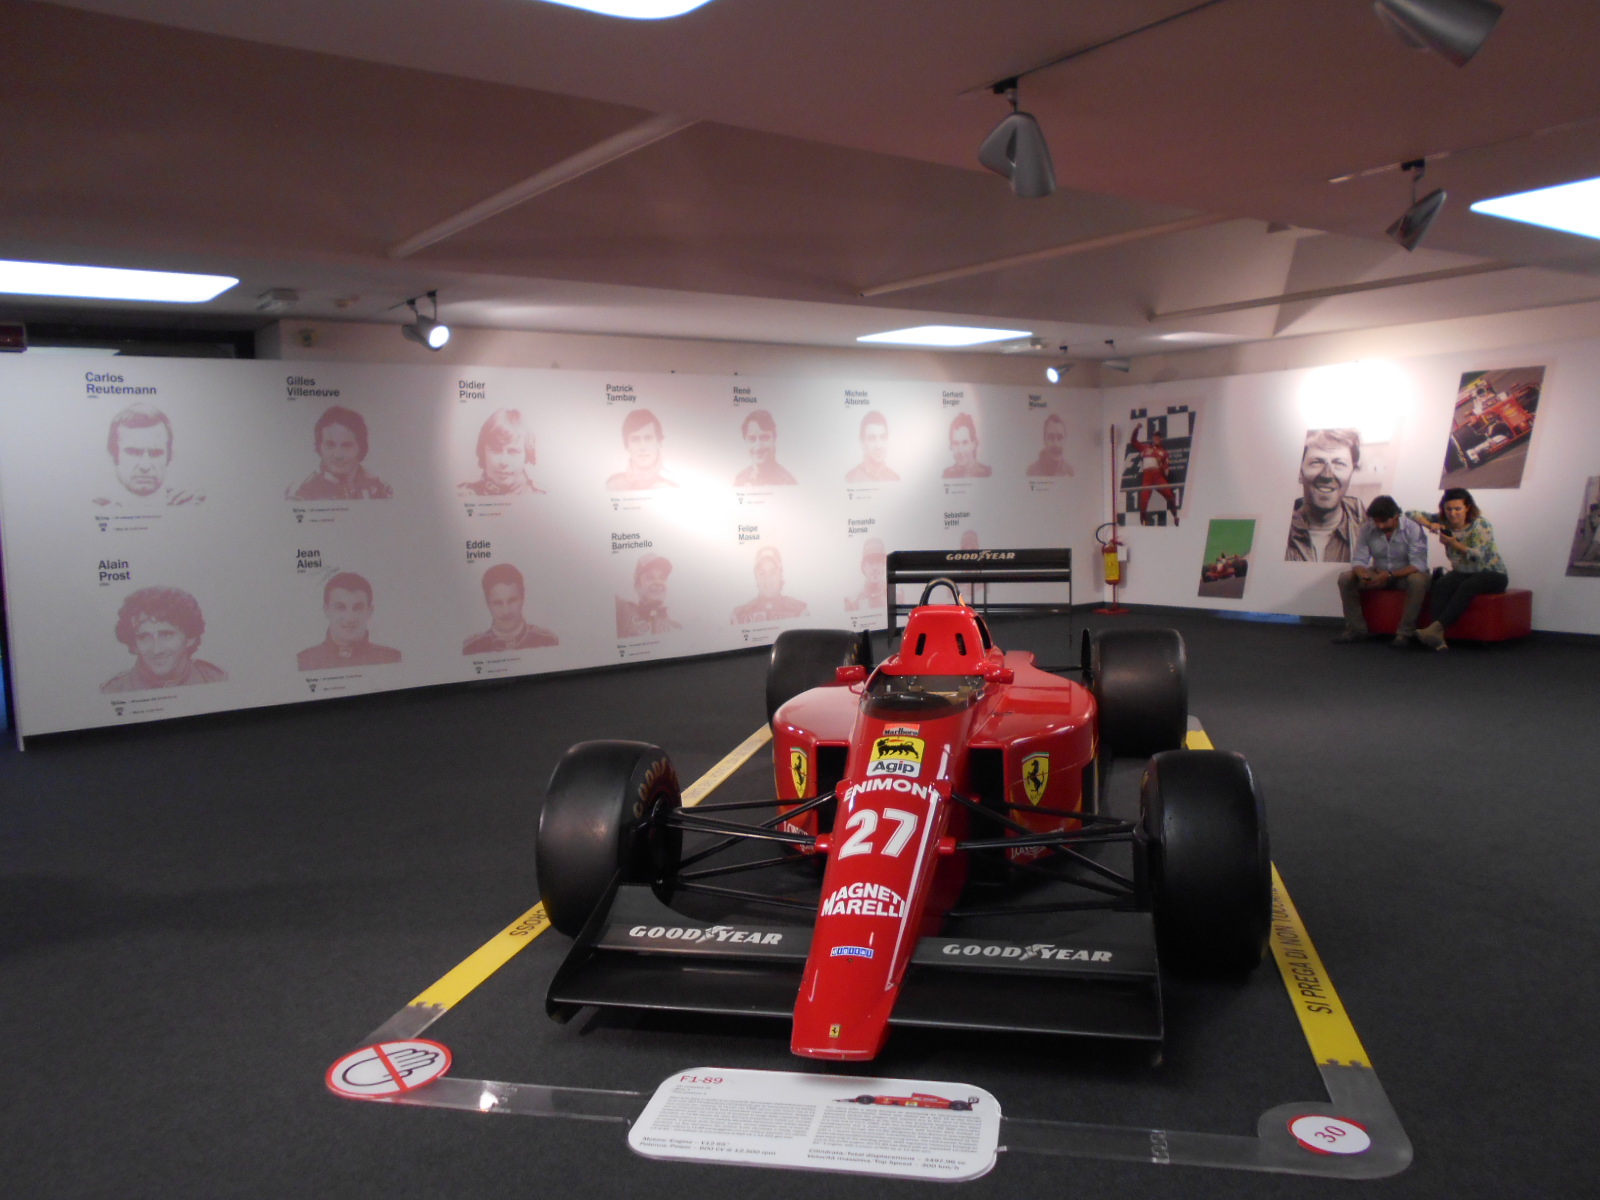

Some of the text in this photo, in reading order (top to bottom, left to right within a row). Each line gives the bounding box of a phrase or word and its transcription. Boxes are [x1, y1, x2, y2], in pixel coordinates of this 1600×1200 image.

[85, 371, 124, 383] Carlos
[286, 376, 316, 386] Gilles
[86, 383, 157, 395] Reutemann
[458, 380, 485, 390] Didier
[606, 384, 634, 393] Patrick
[286, 386, 340, 397] Villeneuve
[458, 390, 486, 400] Pironi
[606, 393, 637, 404] Tambay
[847, 517, 876, 526] Fernando
[738, 524, 758, 533] Felipe
[847, 526, 869, 534] Alonso
[611, 531, 640, 541] Rubens
[738, 532, 760, 541] Massa
[466, 539, 491, 549] Eddie
[611, 539, 653, 550] Barrichello
[296, 549, 320, 559] Jean
[466, 549, 491, 559] Irvine
[98, 559, 129, 570] Alain
[296, 558, 322, 569] Alesi
[99, 570, 131, 581] Prost
[884, 727, 919, 735] Marlboro
[872, 761, 914, 773] Agip
[838, 808, 918, 860] 27
[1275, 925, 1301, 946] NON
[1283, 947, 1308, 959] DI
[1289, 962, 1326, 999] PREGA
[1305, 1000, 1332, 1014] SI
[1314, 1125, 1346, 1143] 30
